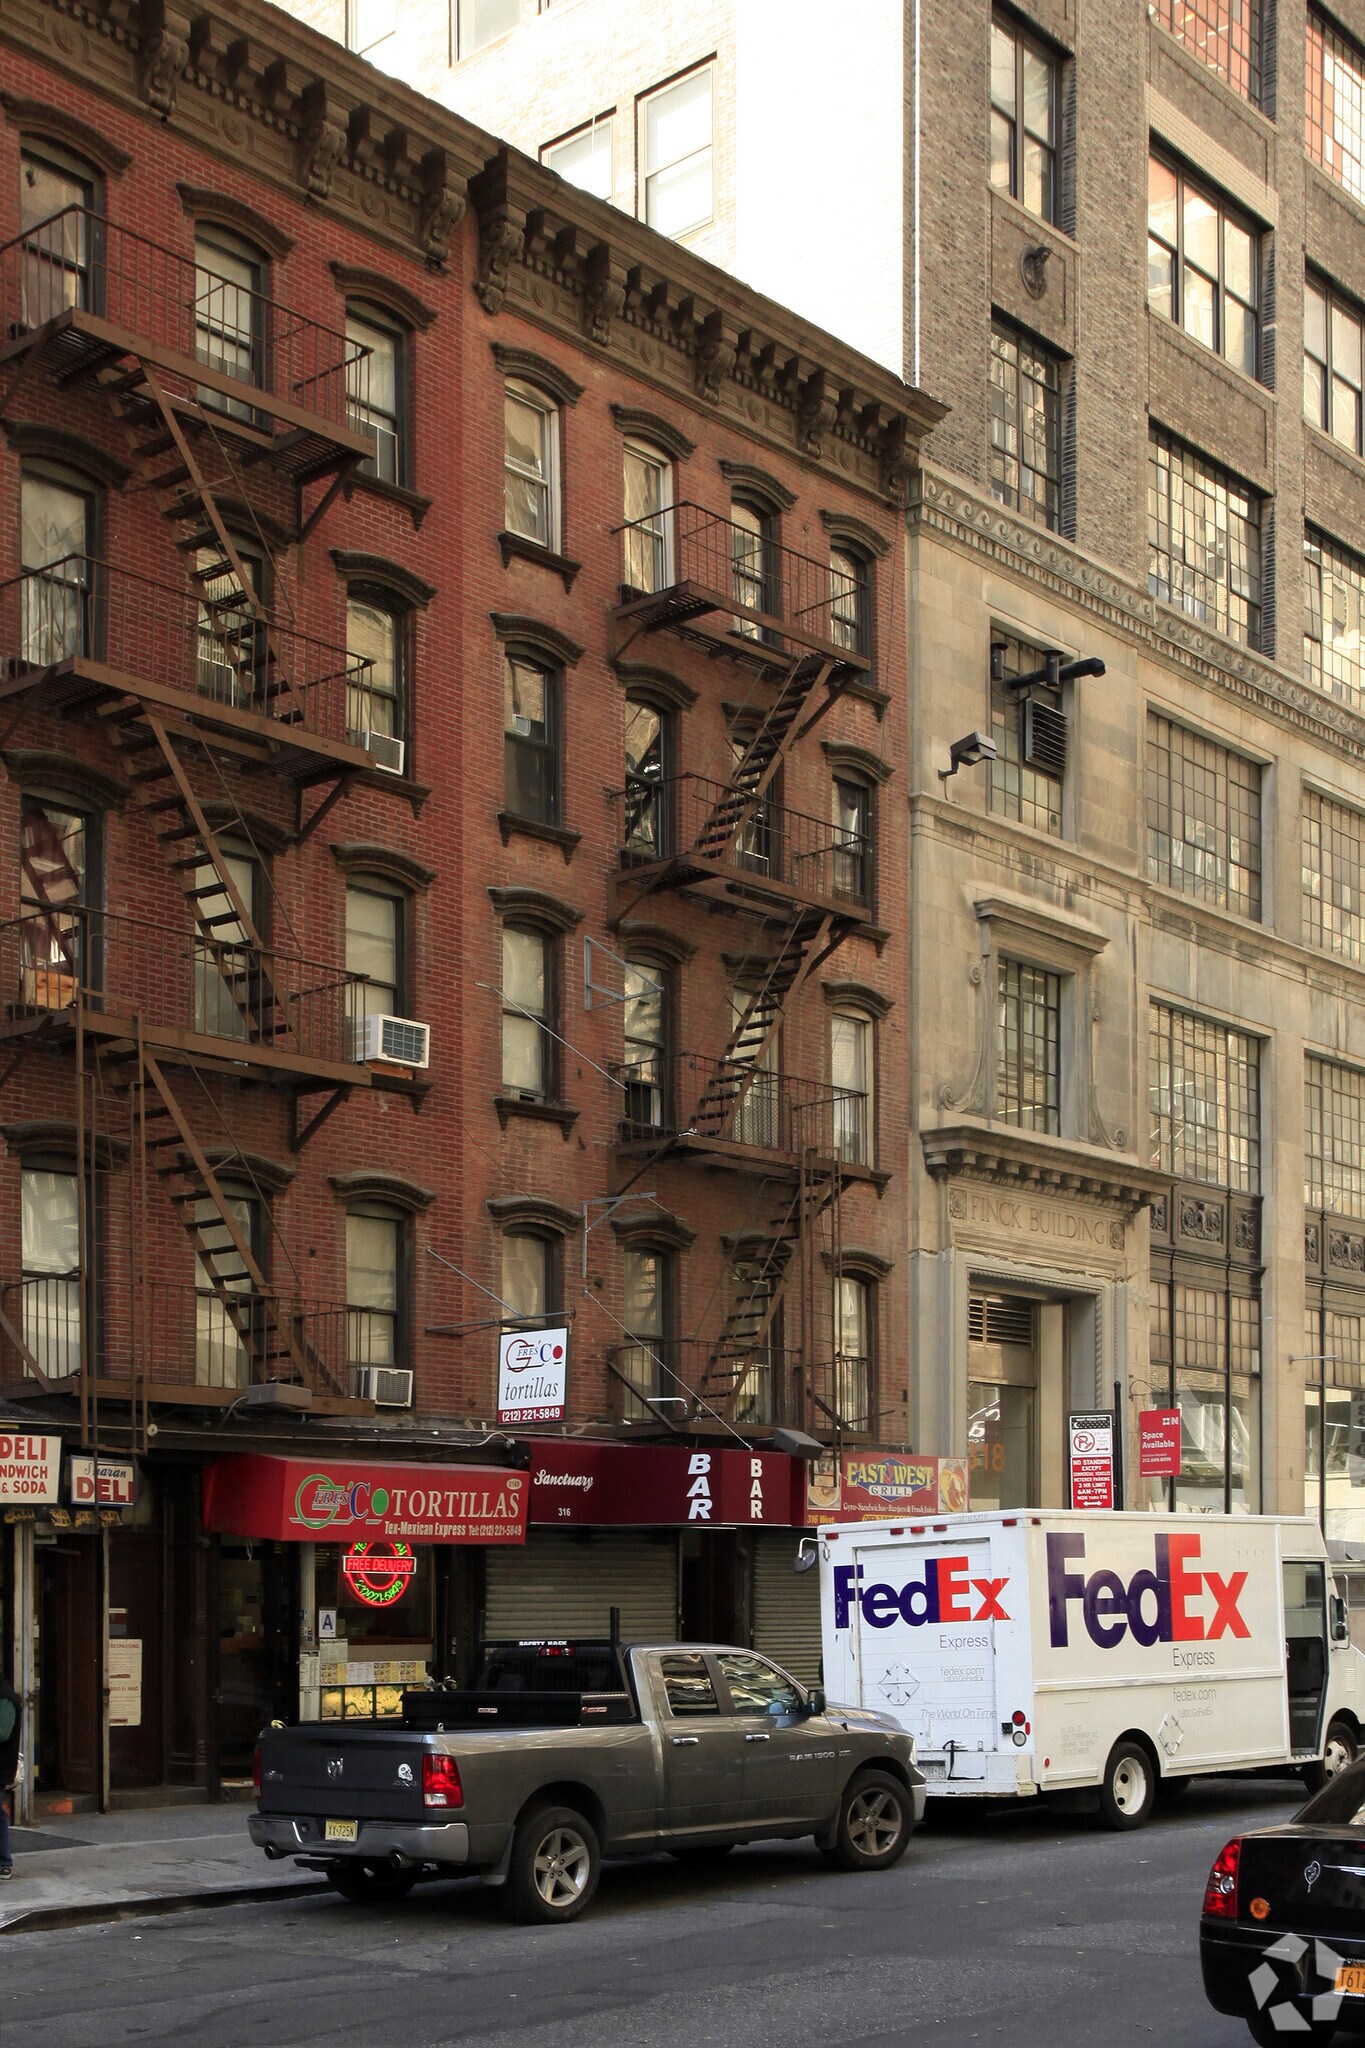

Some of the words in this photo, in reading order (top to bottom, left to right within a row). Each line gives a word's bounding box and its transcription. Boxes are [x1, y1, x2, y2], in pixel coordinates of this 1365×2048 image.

[971, 1196, 1023, 1230] FINCK
[1029, 1207, 1105, 1245] BUILDING
[505, 1377, 559, 1401] tortillas
[502, 1409, 521, 1422] (212)
[522, 1407, 560, 1420] 221-5849
[1142, 1432, 1164, 1440] Space
[1142, 1440, 1175, 1449] Available
[0, 1436, 46, 1461] DELI
[969, 1443, 1005, 1472] 318
[533, 1468, 594, 1493] Sanctuary
[847, 1461, 887, 1487] EAST
[893, 1465, 935, 1490] WEST
[2, 1482, 9, 1494] &
[13, 1480, 47, 1495] SODA
[77, 1476, 135, 1502] DELI
[686, 1453, 713, 1520] BAR
[750, 1458, 763, 1519] BAR
[870, 1486, 911, 1496] GRILL
[392, 1489, 520, 1518] TORTILLAS
[558, 1507, 571, 1517] 316
[807, 1514, 819, 1524] 316
[385, 1520, 433, 1536] Tex-Mexican
[434, 1523, 466, 1538] Express
[347, 1558, 371, 1570] FREE
[372, 1558, 413, 1572] DELIVERY
[833, 1556, 1012, 1629] FedEx
[1046, 1532, 1252, 1649] FedEx
[322, 1614, 333, 1630] A
[940, 1634, 989, 1650] Express
[1173, 1648, 1215, 1669] Express
[940, 1666, 985, 1676] fedex.com
[1173, 1688, 1216, 1702] fedex.com
[921, 1709, 936, 1719] The
[936, 1708, 960, 1719] World
[962, 1708, 975, 1718] On
[976, 1708, 997, 1718] Time
[789, 1753, 813, 1761] RAM
[814, 1751, 836, 1759] 1500
